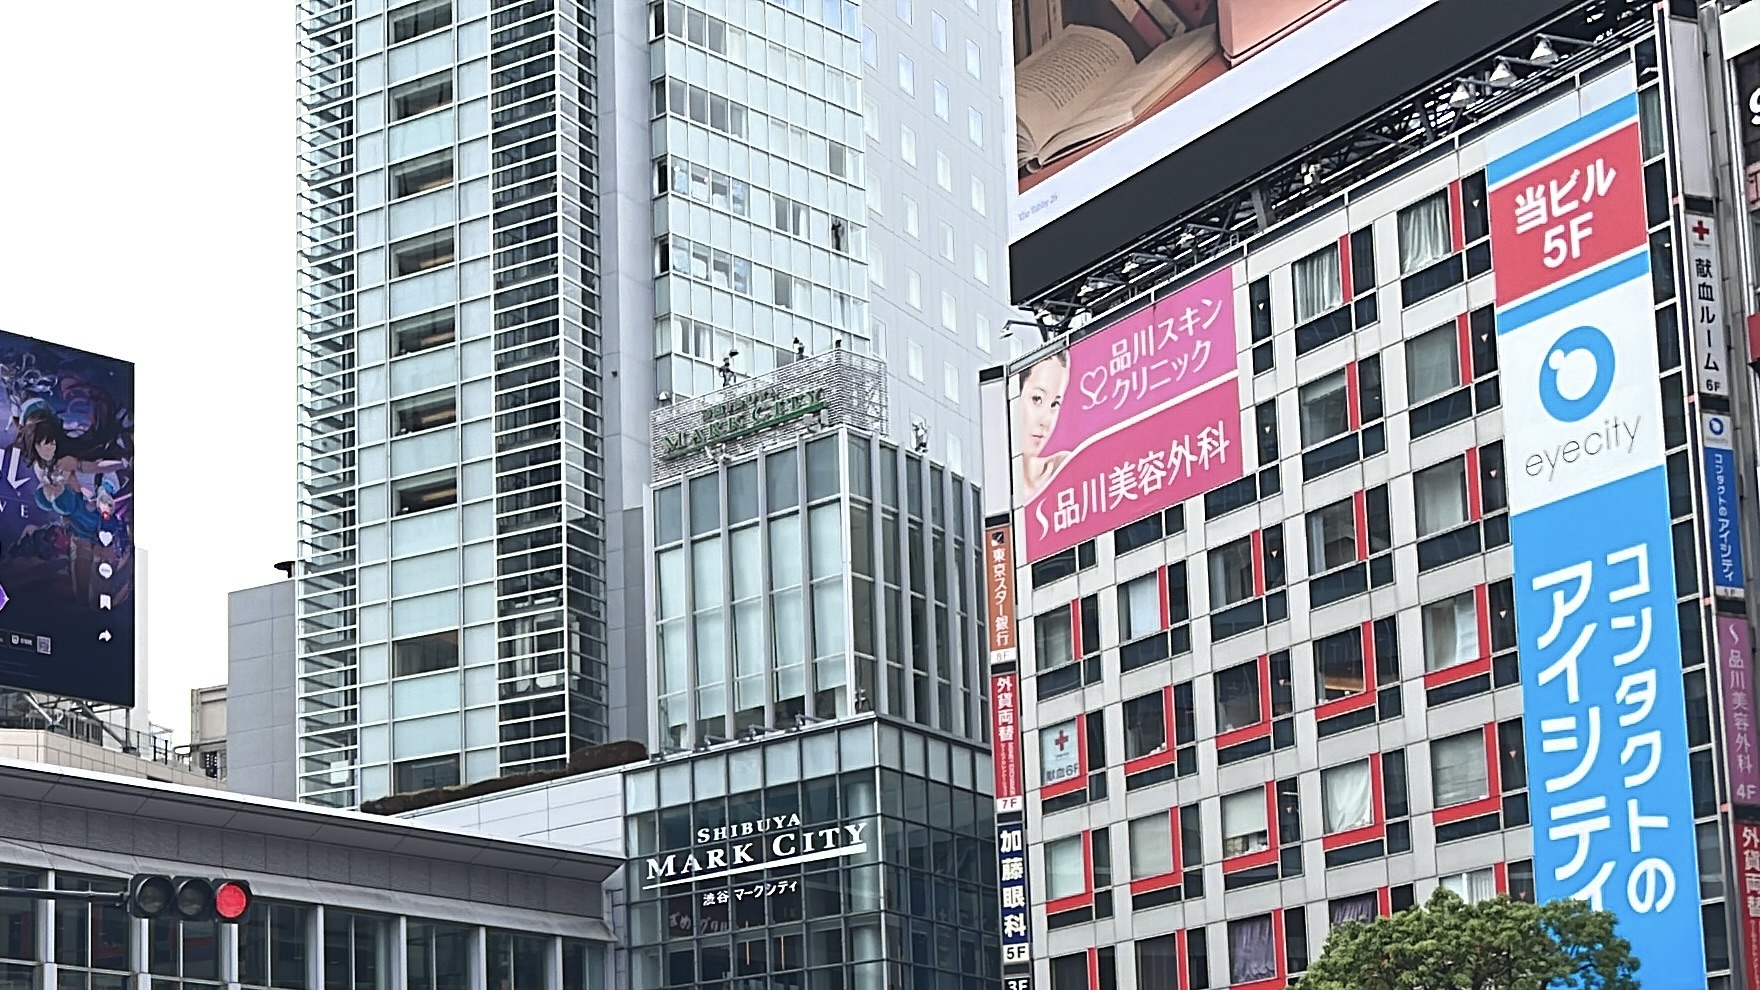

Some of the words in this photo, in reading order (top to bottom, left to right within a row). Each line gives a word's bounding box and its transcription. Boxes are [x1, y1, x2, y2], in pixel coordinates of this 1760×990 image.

[1514, 158, 1617, 235] 当ビル
[1543, 211, 1594, 268] 5F
[1109, 299, 1223, 377] 品川スキン
[1695, 258, 1719, 371] 献血ルーム
[1112, 339, 1212, 410] クリニック
[1706, 377, 1720, 392] 6F
[1053, 420, 1230, 534] 品川美容外科
[1525, 415, 1642, 482] eyecity
[992, 548, 1009, 647] 東京スター銀行
[997, 676, 1014, 742] 外貨両替
[1606, 542, 1676, 914] コンタクトの
[1728, 649, 1752, 774] 品川美容外科
[1001, 799, 1018, 809] 7F
[1736, 783, 1756, 799] 4F
[645, 842, 755, 880] MARK
[772, 822, 868, 857] CITY
[697, 813, 801, 844] SHIBUYA
[702, 889, 729, 907] 渋谷
[734, 880, 798, 901] マークシティ
[1000, 829, 1027, 938] 加藤眼科
[1006, 946, 1026, 960] 5F
